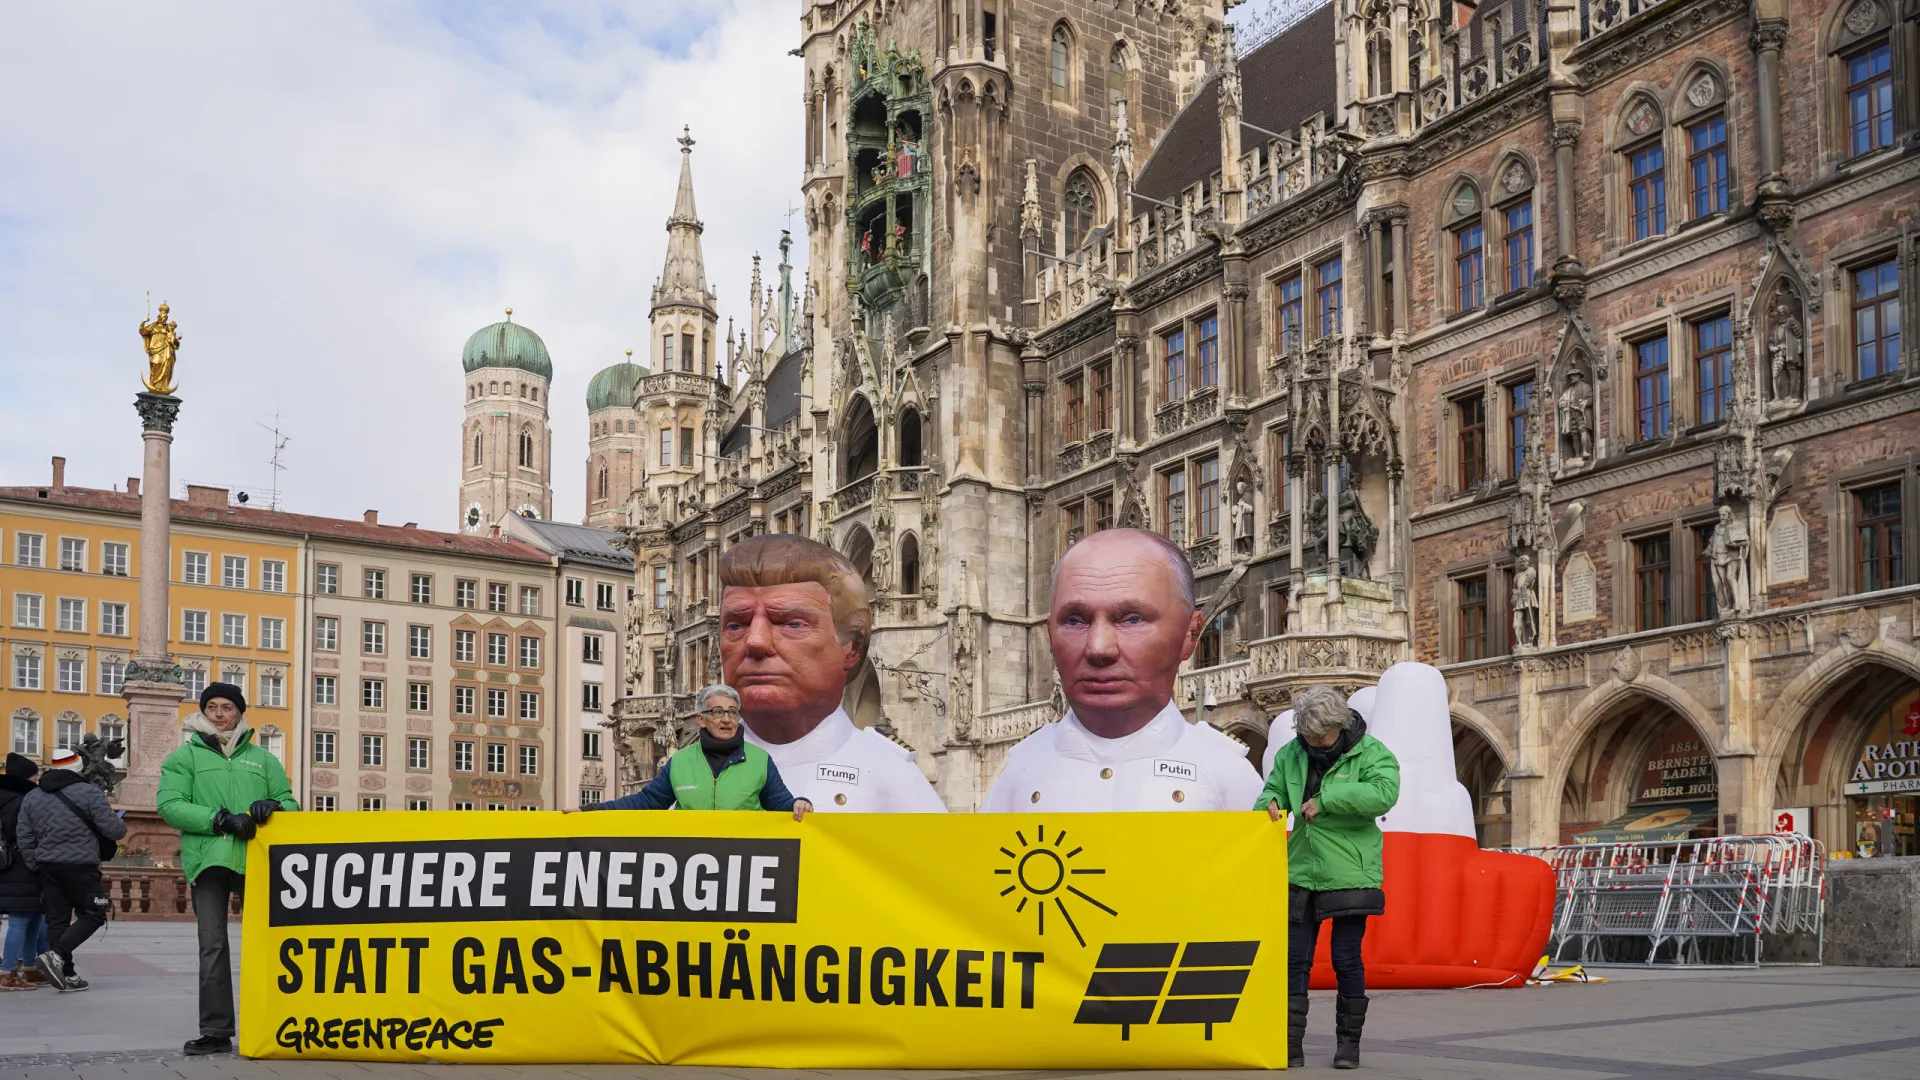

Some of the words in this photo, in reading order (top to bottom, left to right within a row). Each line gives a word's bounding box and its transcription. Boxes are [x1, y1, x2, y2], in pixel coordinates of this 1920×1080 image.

[1670, 742, 1700, 753] 1884
[819, 767, 856, 782] Trump
[1159, 763, 1191, 776] Putin
[1663, 767, 1707, 780] LADEN
[1850, 760, 1920, 781] APOT
[1642, 787, 1683, 798] AMBER
[279, 851, 511, 910] SICHERE
[529, 851, 780, 913] ENERGIE
[277, 936, 430, 994] STATT
[452, 928, 1045, 1009] GAS-ABHÄNGIGKEIT
[275, 1016, 505, 1054] GREENPEACE
